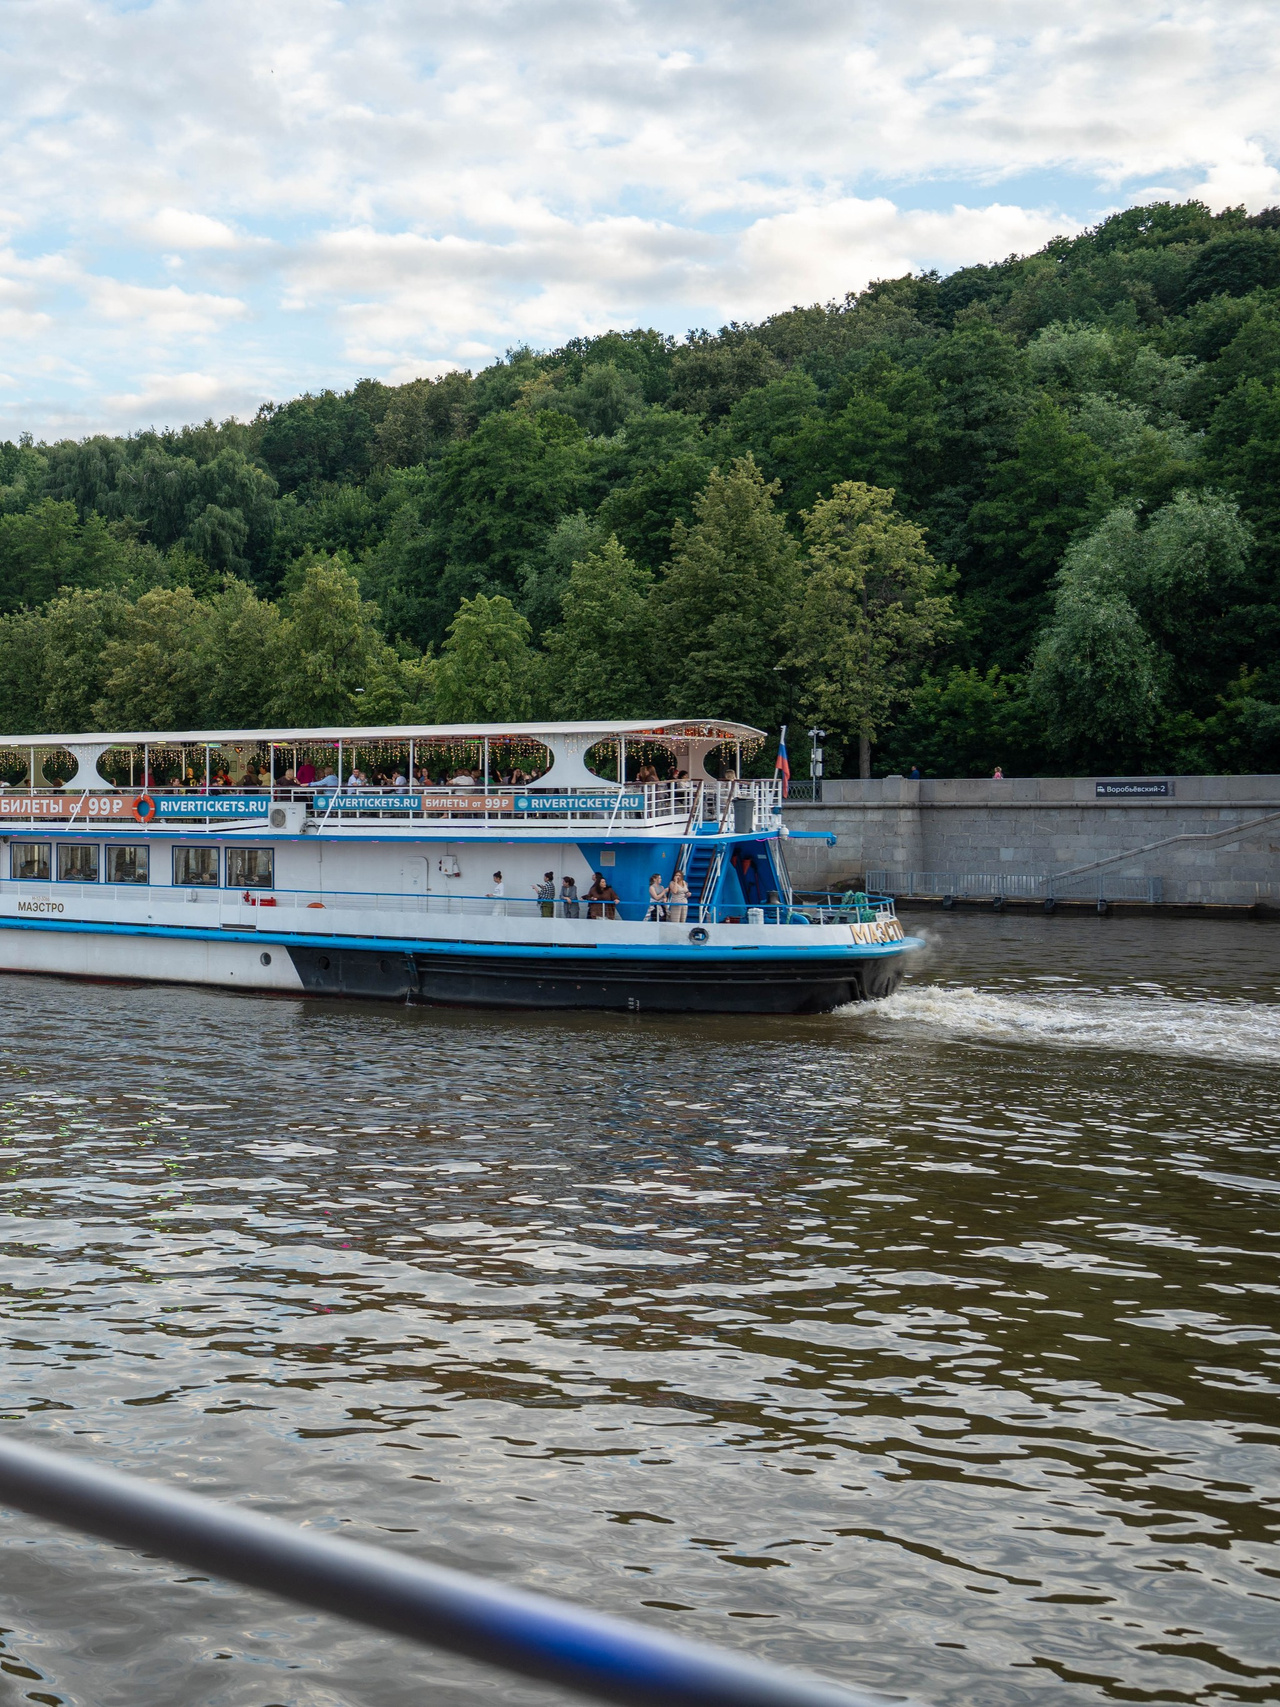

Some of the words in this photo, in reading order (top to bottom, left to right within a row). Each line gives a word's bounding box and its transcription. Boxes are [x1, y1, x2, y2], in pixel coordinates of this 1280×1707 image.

[1106, 785, 1166, 793] Воробьёвский-2
[1, 799, 62, 813] БИЛЕТЫ
[160, 801, 266, 812] RIVERTICKETS.RU
[328, 798, 418, 808] RIVERTICKETS.RU
[425, 799, 468, 808] БИЛЕТЫ
[531, 797, 638, 808] RIVERTICKETS.RU
[18, 901, 65, 913] МАЭСТРО
